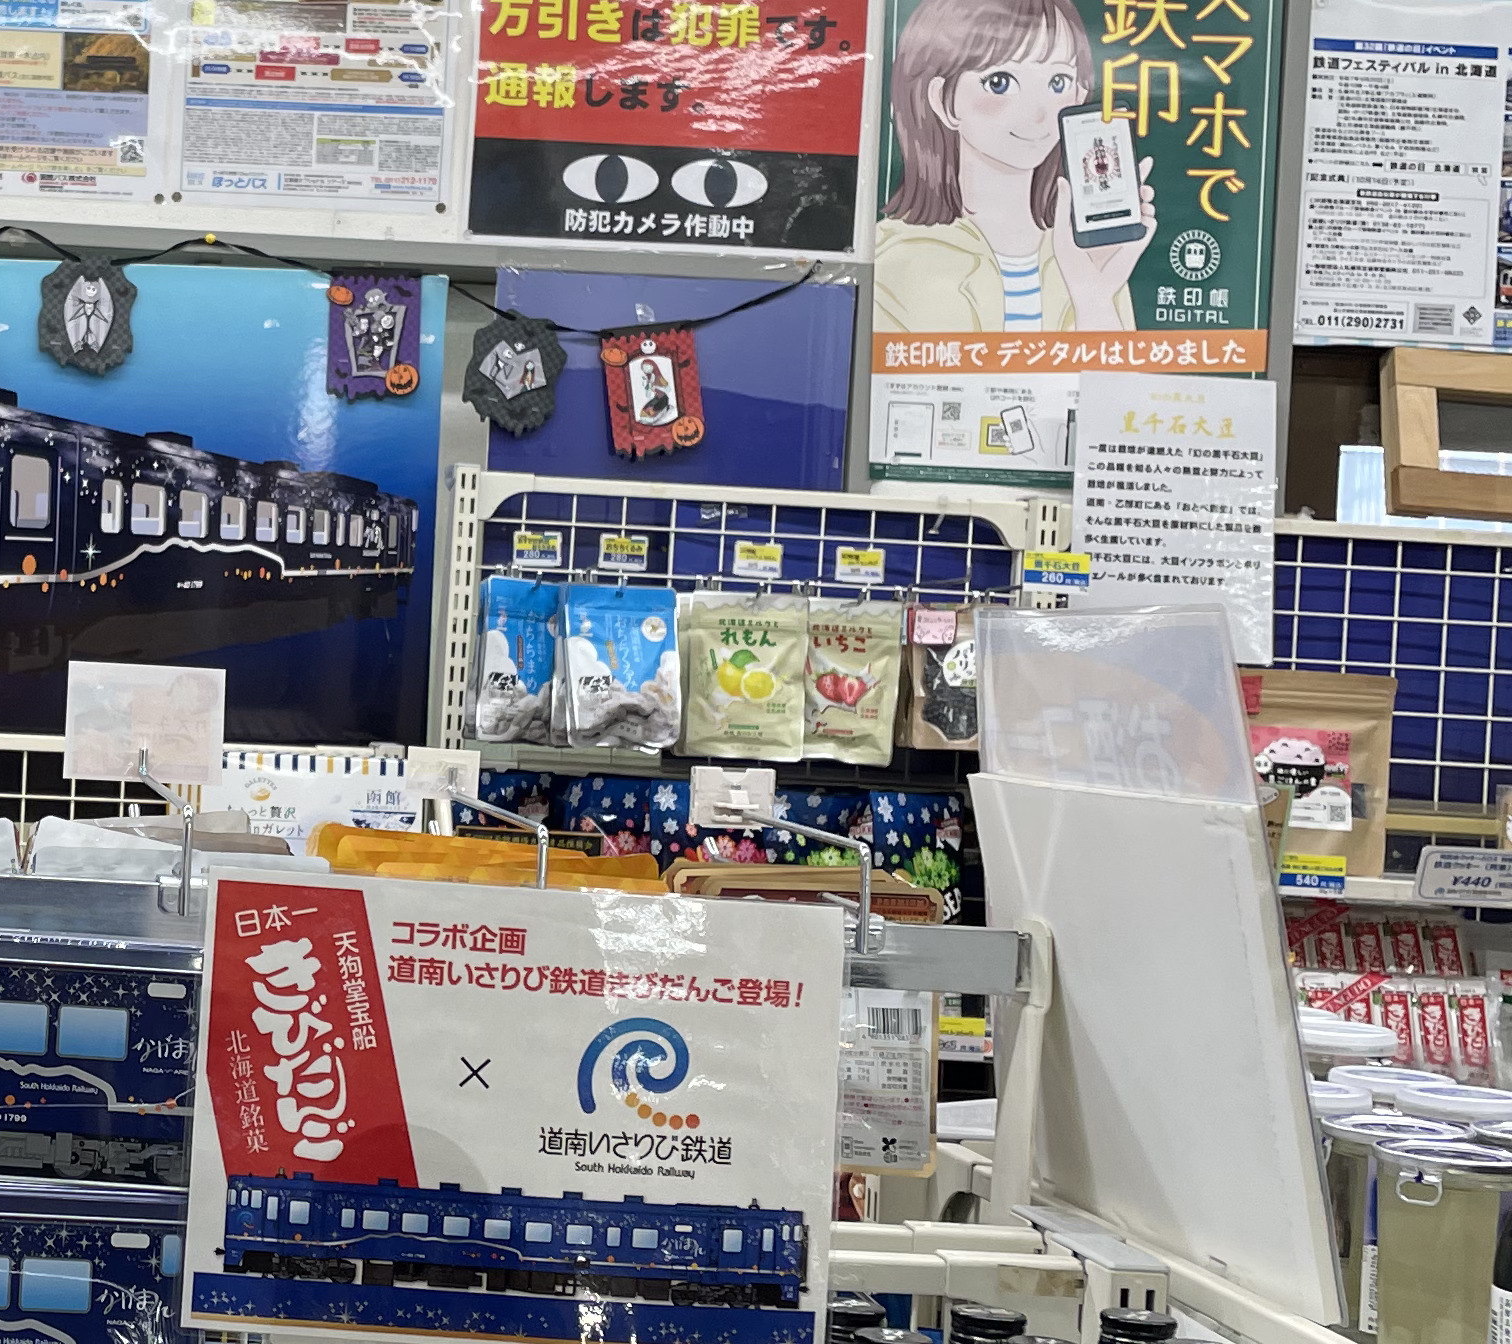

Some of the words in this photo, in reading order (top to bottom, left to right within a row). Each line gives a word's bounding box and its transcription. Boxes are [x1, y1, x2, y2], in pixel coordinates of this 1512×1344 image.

[1312, 55, 1431, 74] 鉄道フェスティバル
[1434, 60, 1449, 75] in
[1454, 63, 1498, 78] 北海道
[485, 63, 705, 113] 通報します。
[565, 209, 754, 239] 防犯カメラ作動中
[1157, 286, 1230, 309] 鉄印帳
[1156, 308, 1230, 325] DIGITAL
[1318, 315, 1406, 331] 011(290)2731
[721, 628, 776, 647] れもん
[812, 634, 866, 654] いちご
[1296, 875, 1319, 887] 540
[234, 904, 319, 937] 日本一
[391, 921, 528, 956] コラボ企画
[333, 930, 378, 1052] 天狗堂宝船
[244, 937, 358, 1163] きびだんご
[20, 1081, 40, 1091] South
[41, 1082, 69, 1093] Hokkaido
[71, 1084, 99, 1095] Railway
[225, 1029, 270, 1154] 北海道銘菓
[538, 1125, 732, 1167] 道南いさりび鉄道
[574, 1160, 605, 1175] South
[606, 1162, 654, 1178] Hokkaido
[655, 1164, 696, 1180] Railway
